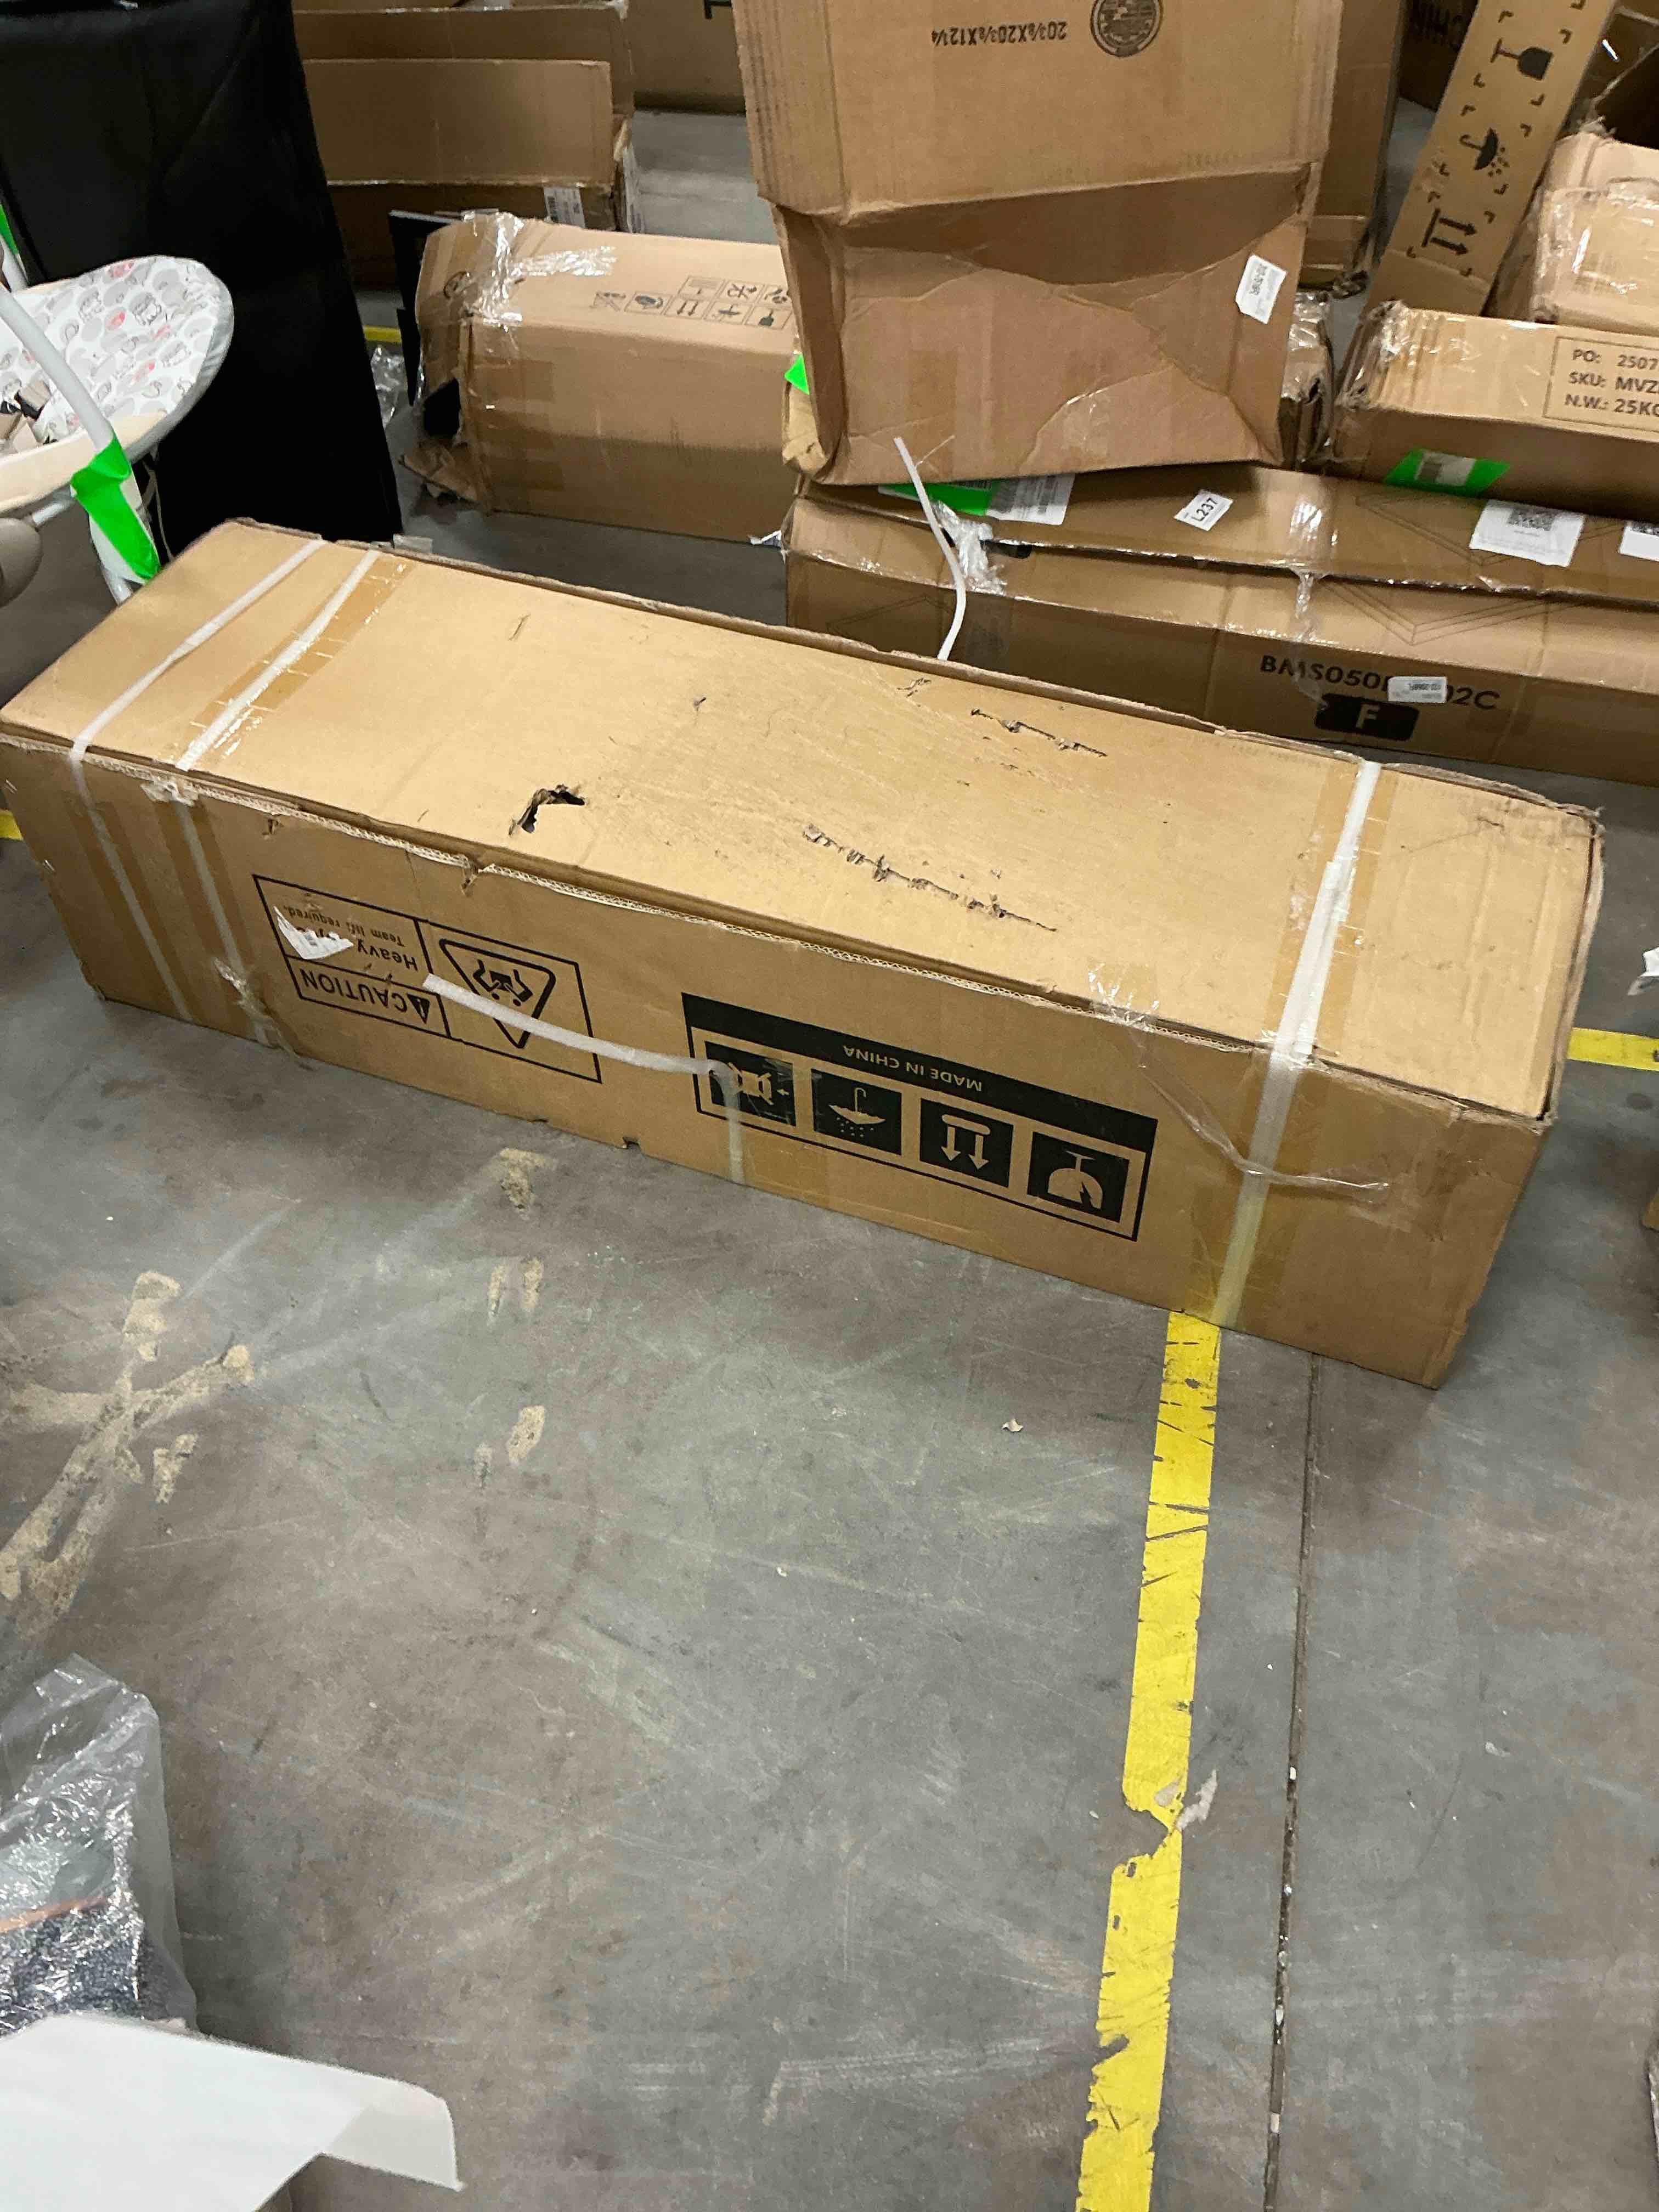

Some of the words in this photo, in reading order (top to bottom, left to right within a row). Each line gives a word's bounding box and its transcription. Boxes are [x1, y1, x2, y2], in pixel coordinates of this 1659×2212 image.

[1572, 348, 1601, 364] PO:
[1568, 371, 1606, 388] SKU:
[1615, 376, 1659, 394] MVZ
[1191, 498, 1218, 521] L237
[1355, 703, 1381, 729] F
[283, 905, 340, 928] required.
[371, 928, 405, 947] Team
[357, 939, 419, 972] Heavy
[300, 968, 408, 1013] CAUTION
[843, 1045, 900, 1069] CHINA
[906, 1062, 924, 1076] IN
[930, 1068, 982, 1092] MADE
